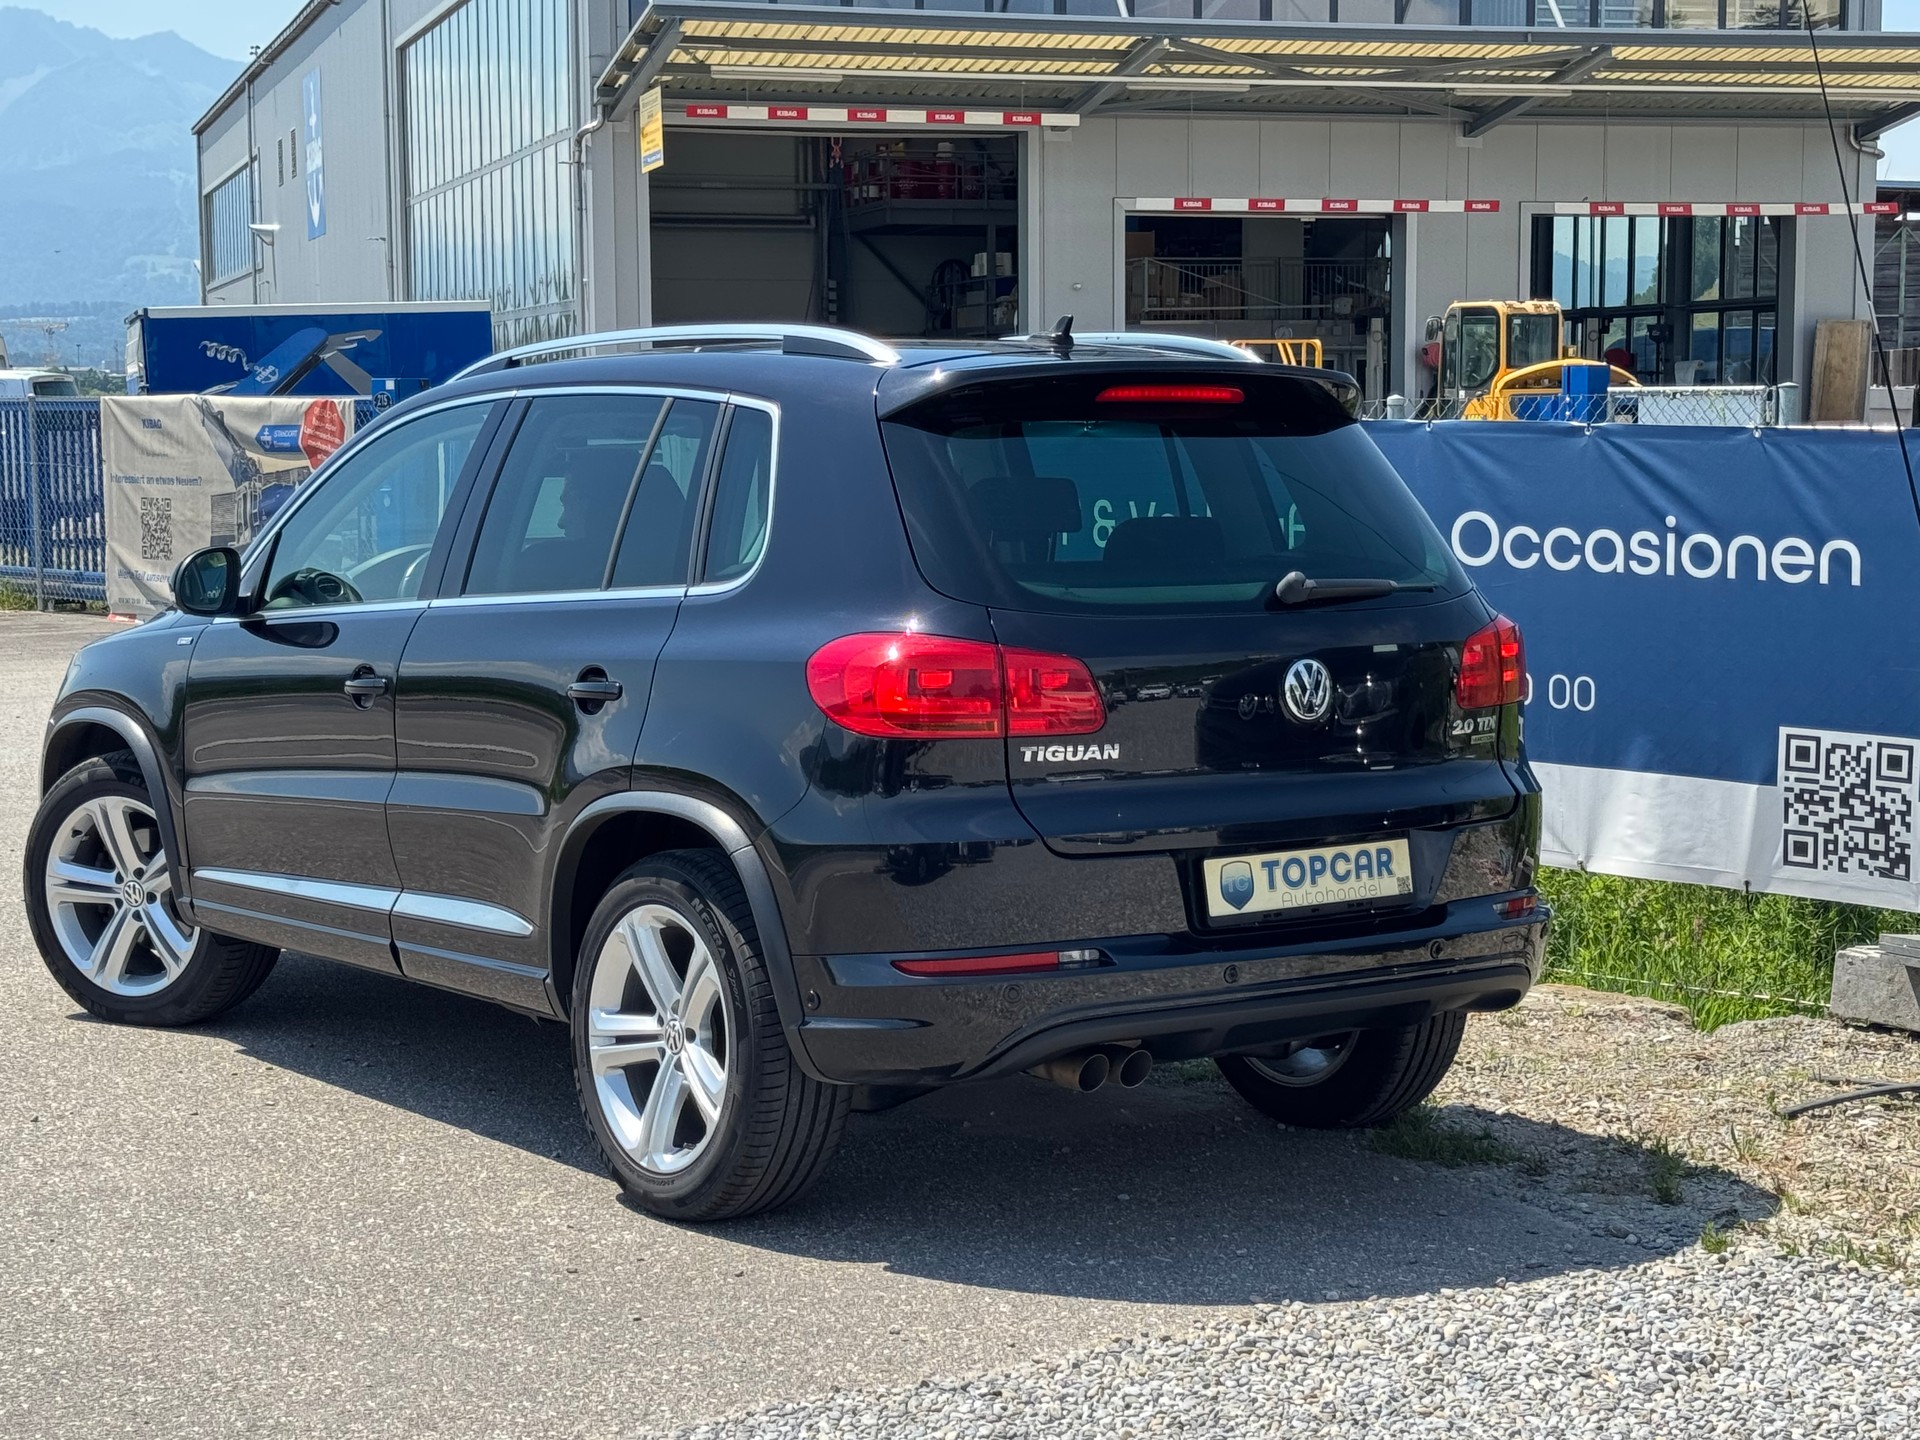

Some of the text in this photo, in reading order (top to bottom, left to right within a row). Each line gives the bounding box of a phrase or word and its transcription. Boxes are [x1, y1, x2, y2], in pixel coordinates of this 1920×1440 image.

[1451, 510, 1861, 586] Occasionen
[1549, 674, 1596, 712] 00
[1020, 743, 1120, 763] TIGUAN
[1261, 846, 1395, 892] TOPCAR
[1281, 881, 1382, 907] Autohandel
